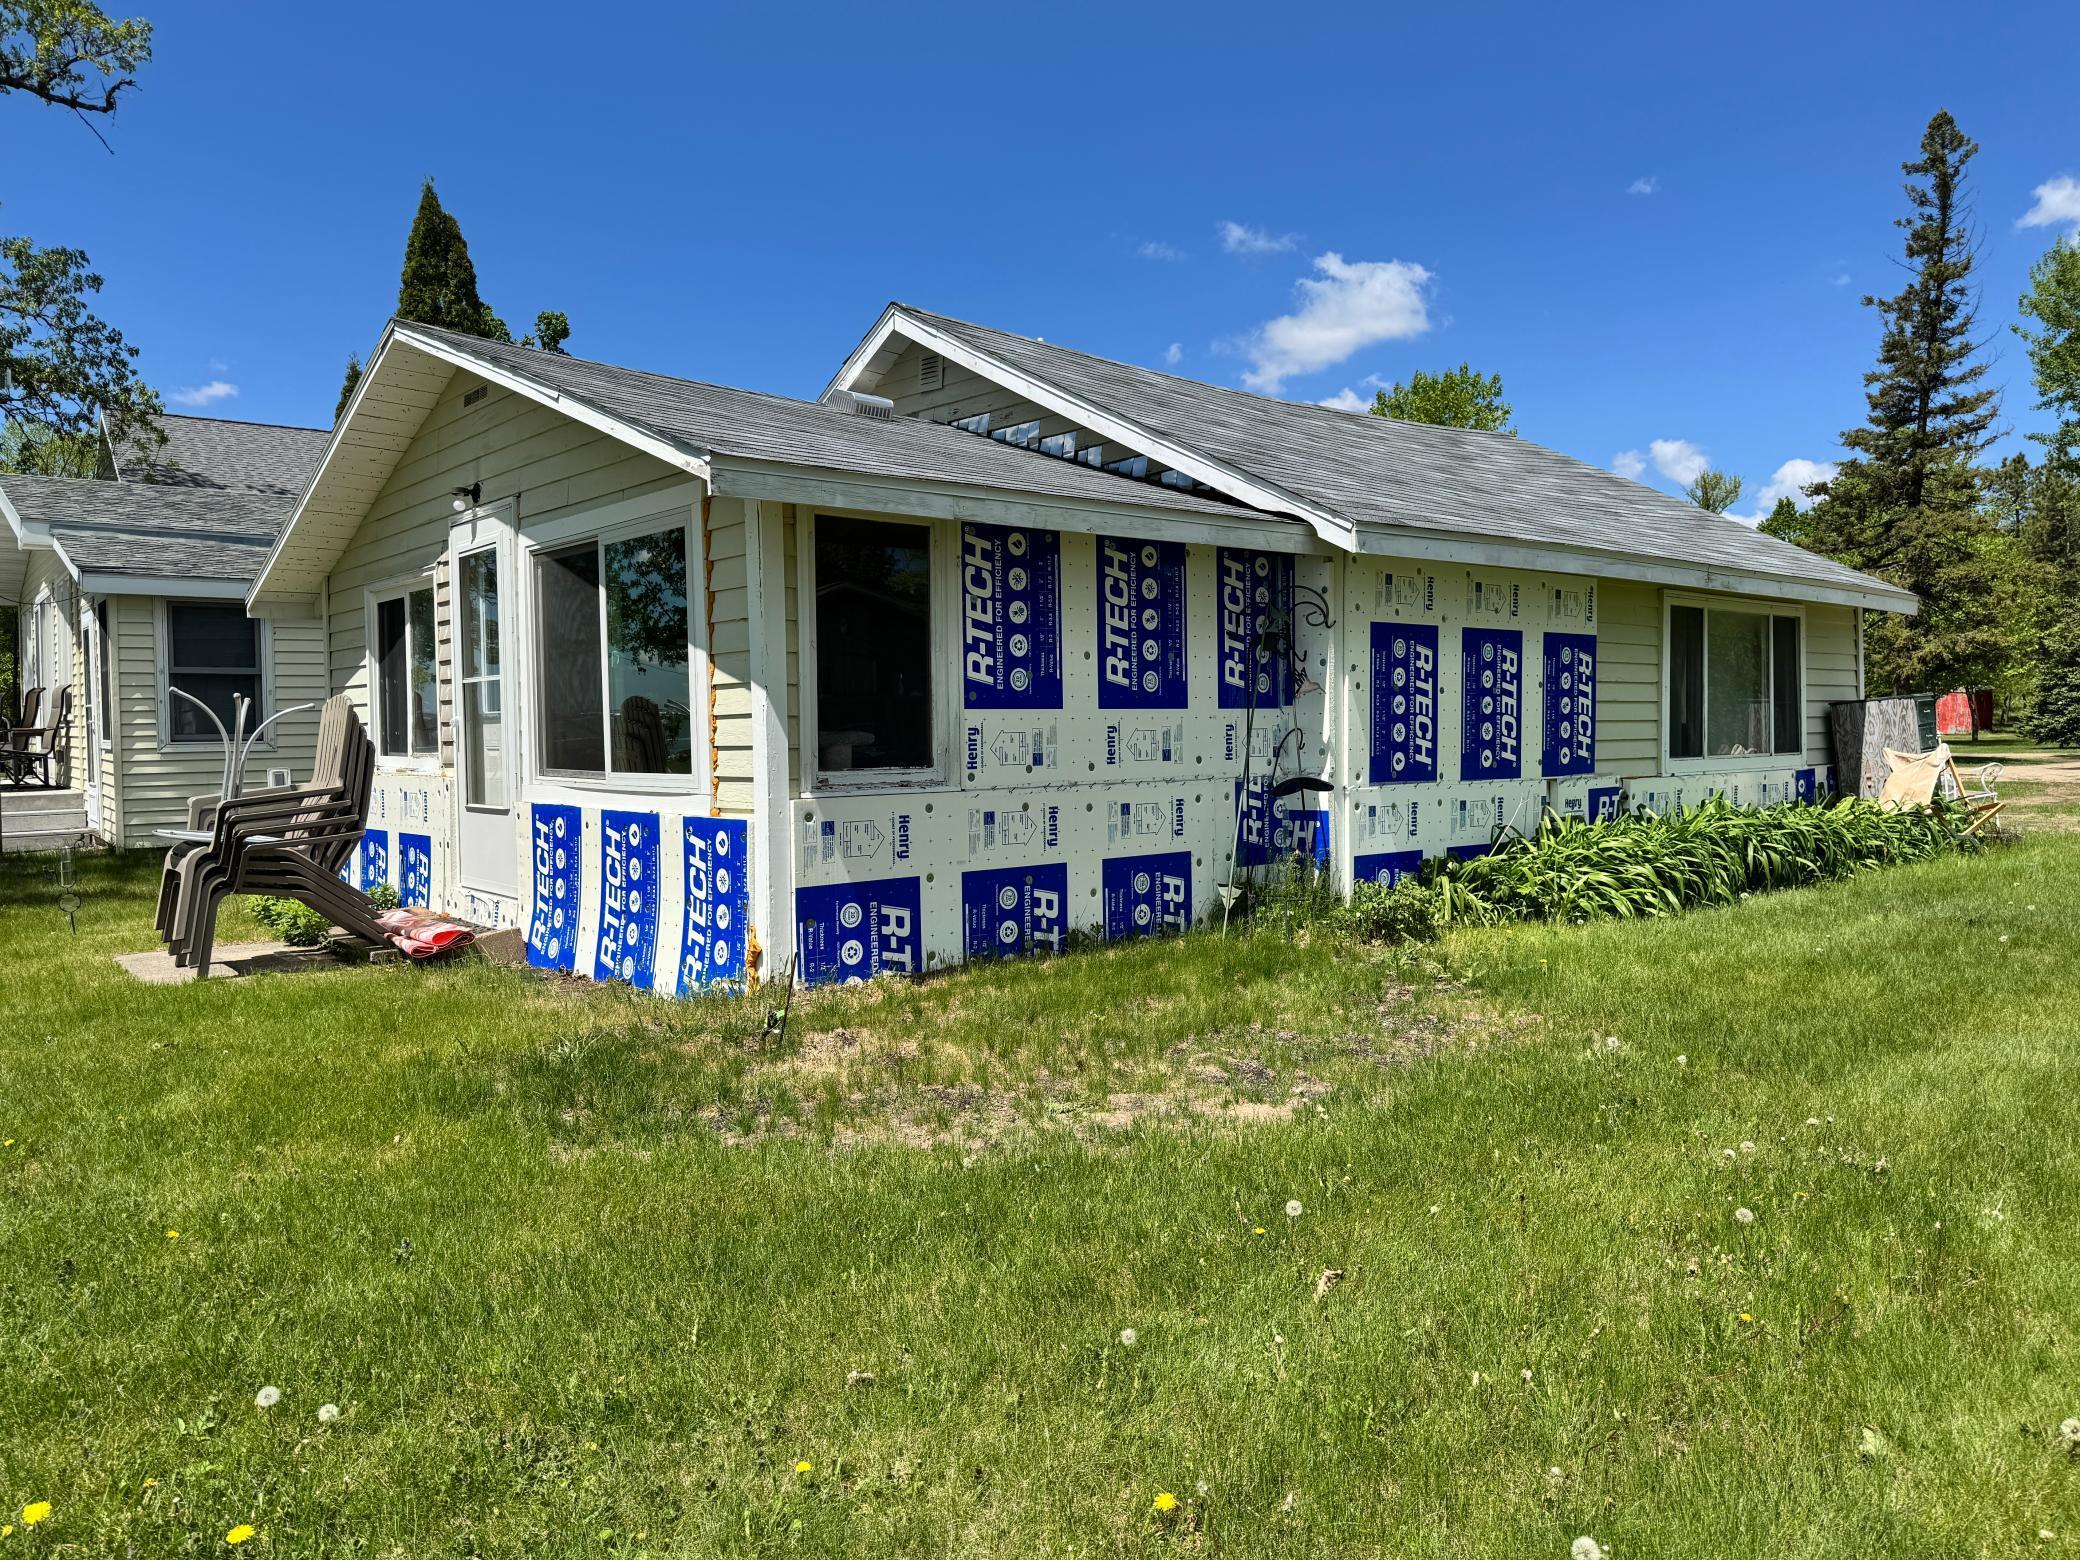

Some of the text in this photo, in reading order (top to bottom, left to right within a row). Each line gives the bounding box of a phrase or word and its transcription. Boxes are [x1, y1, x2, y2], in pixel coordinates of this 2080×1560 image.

[1129, 552, 1137, 606] EFFICIENCY
[1426, 576, 1434, 611] Henry
[994, 539, 1004, 690] ENGINEERED FOR EFFICIENCY
[967, 727, 980, 770] Henry
[1107, 725, 1118, 765] Henry
[1225, 724, 1234, 761] Henry
[897, 815, 910, 859] Henry
[1048, 806, 1058, 847] Henry
[1175, 799, 1185, 836] Henry
[1410, 802, 1418, 837] Henry
